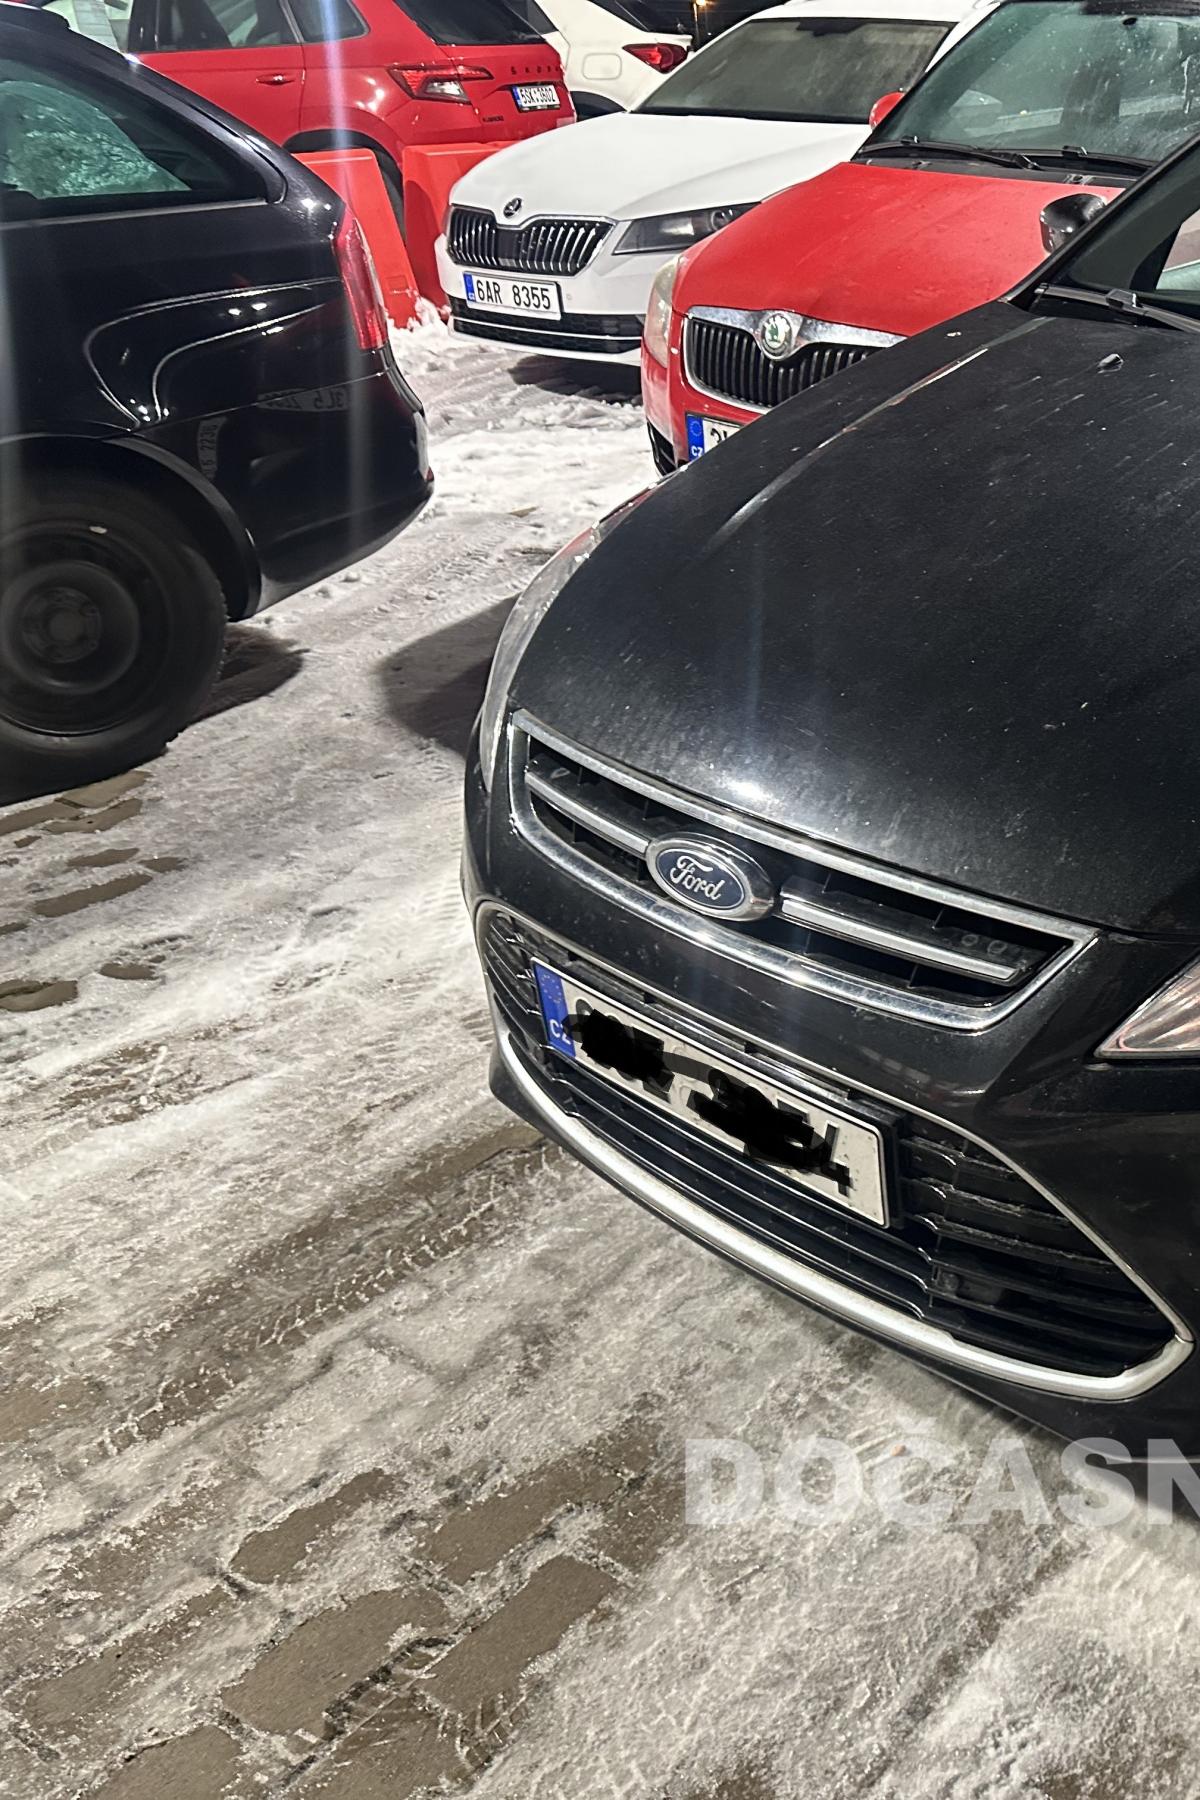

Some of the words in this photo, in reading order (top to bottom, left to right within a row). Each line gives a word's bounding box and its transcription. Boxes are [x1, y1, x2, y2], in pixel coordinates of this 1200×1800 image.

[476, 280, 502, 304] 6AR
[512, 285, 551, 310] 8355
[670, 855, 726, 900] Ford
